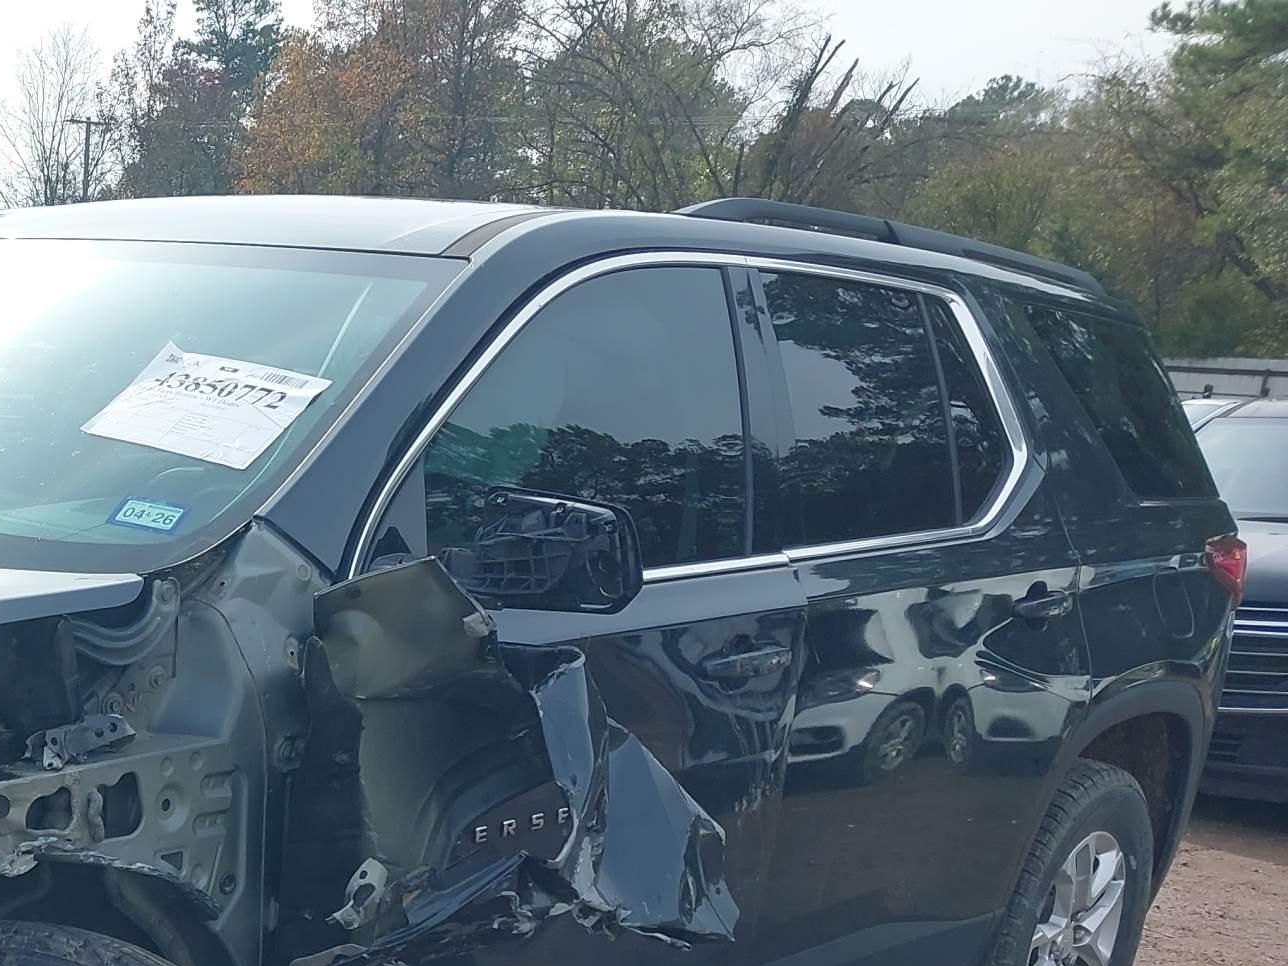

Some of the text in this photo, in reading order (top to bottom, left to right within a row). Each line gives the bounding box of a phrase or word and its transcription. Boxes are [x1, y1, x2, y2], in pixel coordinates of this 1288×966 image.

[154, 371, 288, 410] 43850772
[122, 507, 176, 526] 04 26
